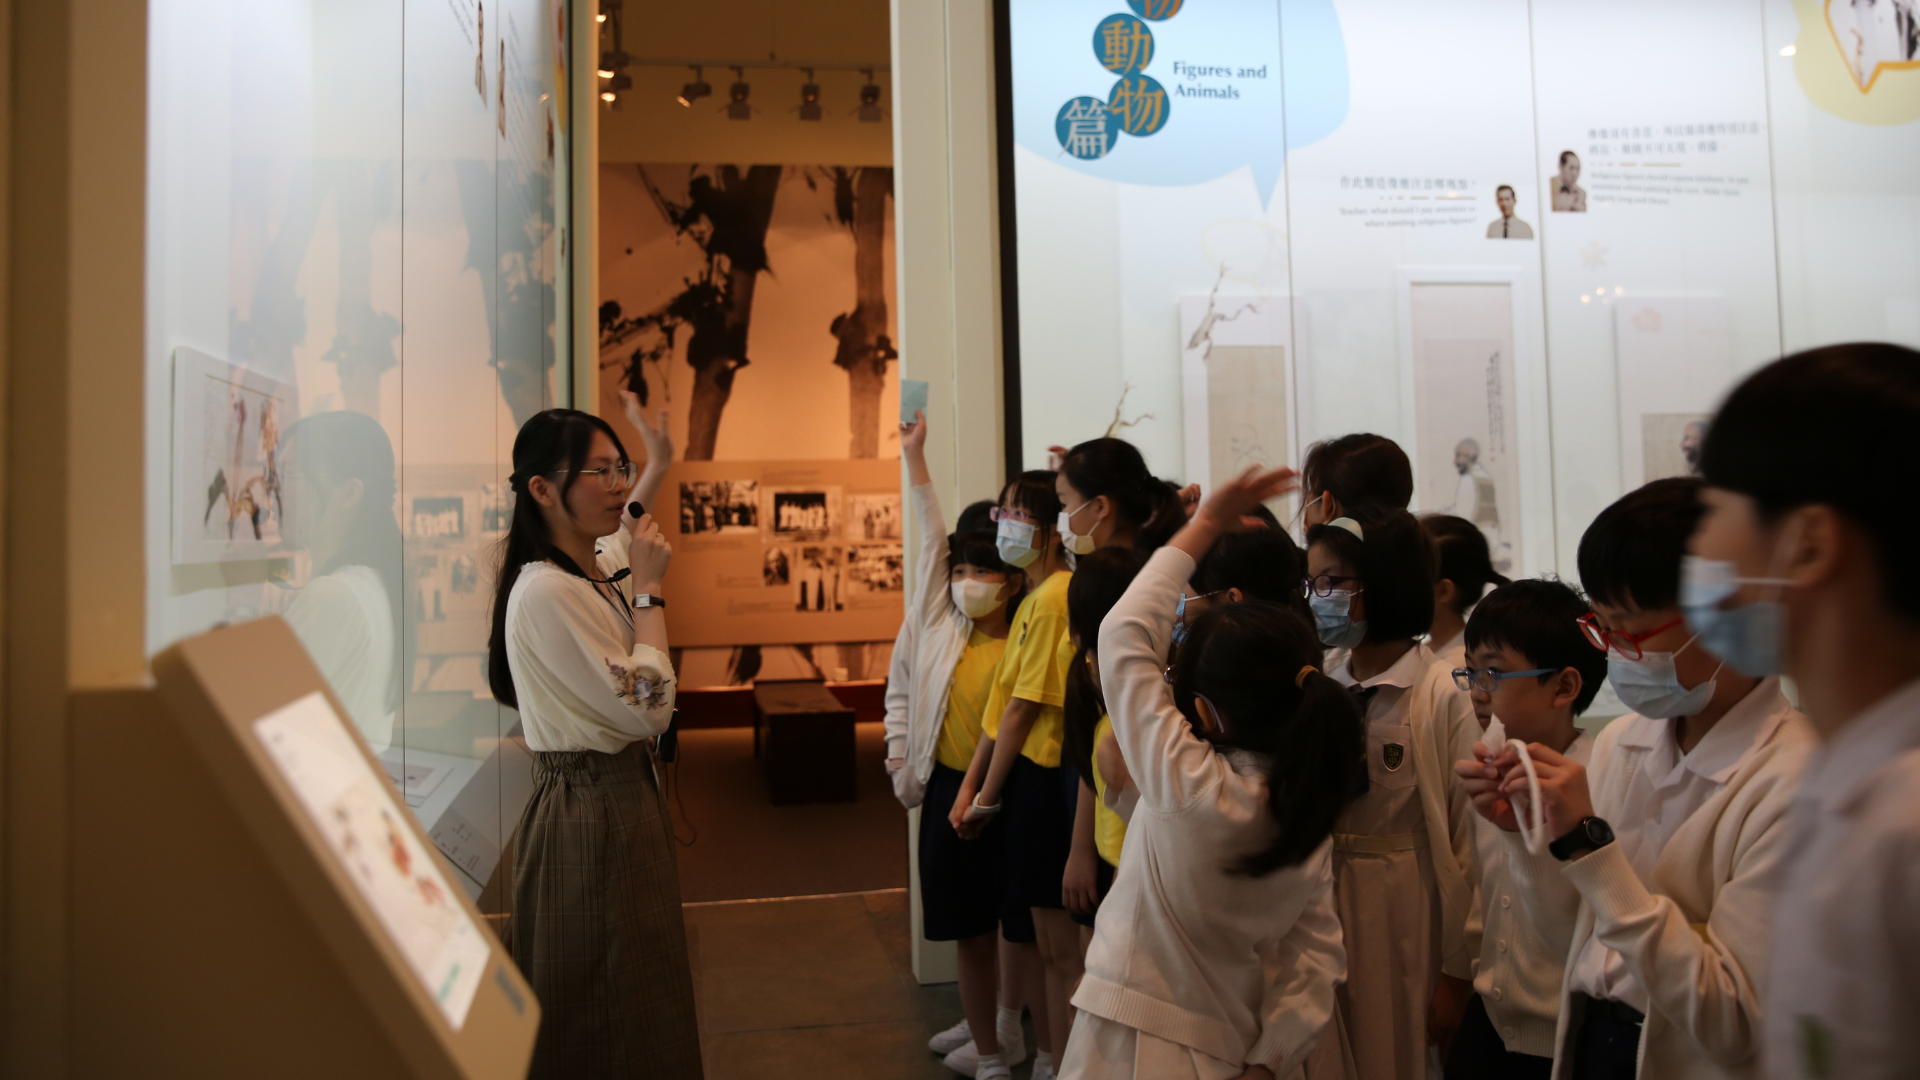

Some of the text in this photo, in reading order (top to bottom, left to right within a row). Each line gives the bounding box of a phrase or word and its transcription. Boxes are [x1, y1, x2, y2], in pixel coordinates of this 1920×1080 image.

[1173, 61, 1267, 80] Figures and
[1175, 83, 1240, 100] Animals
